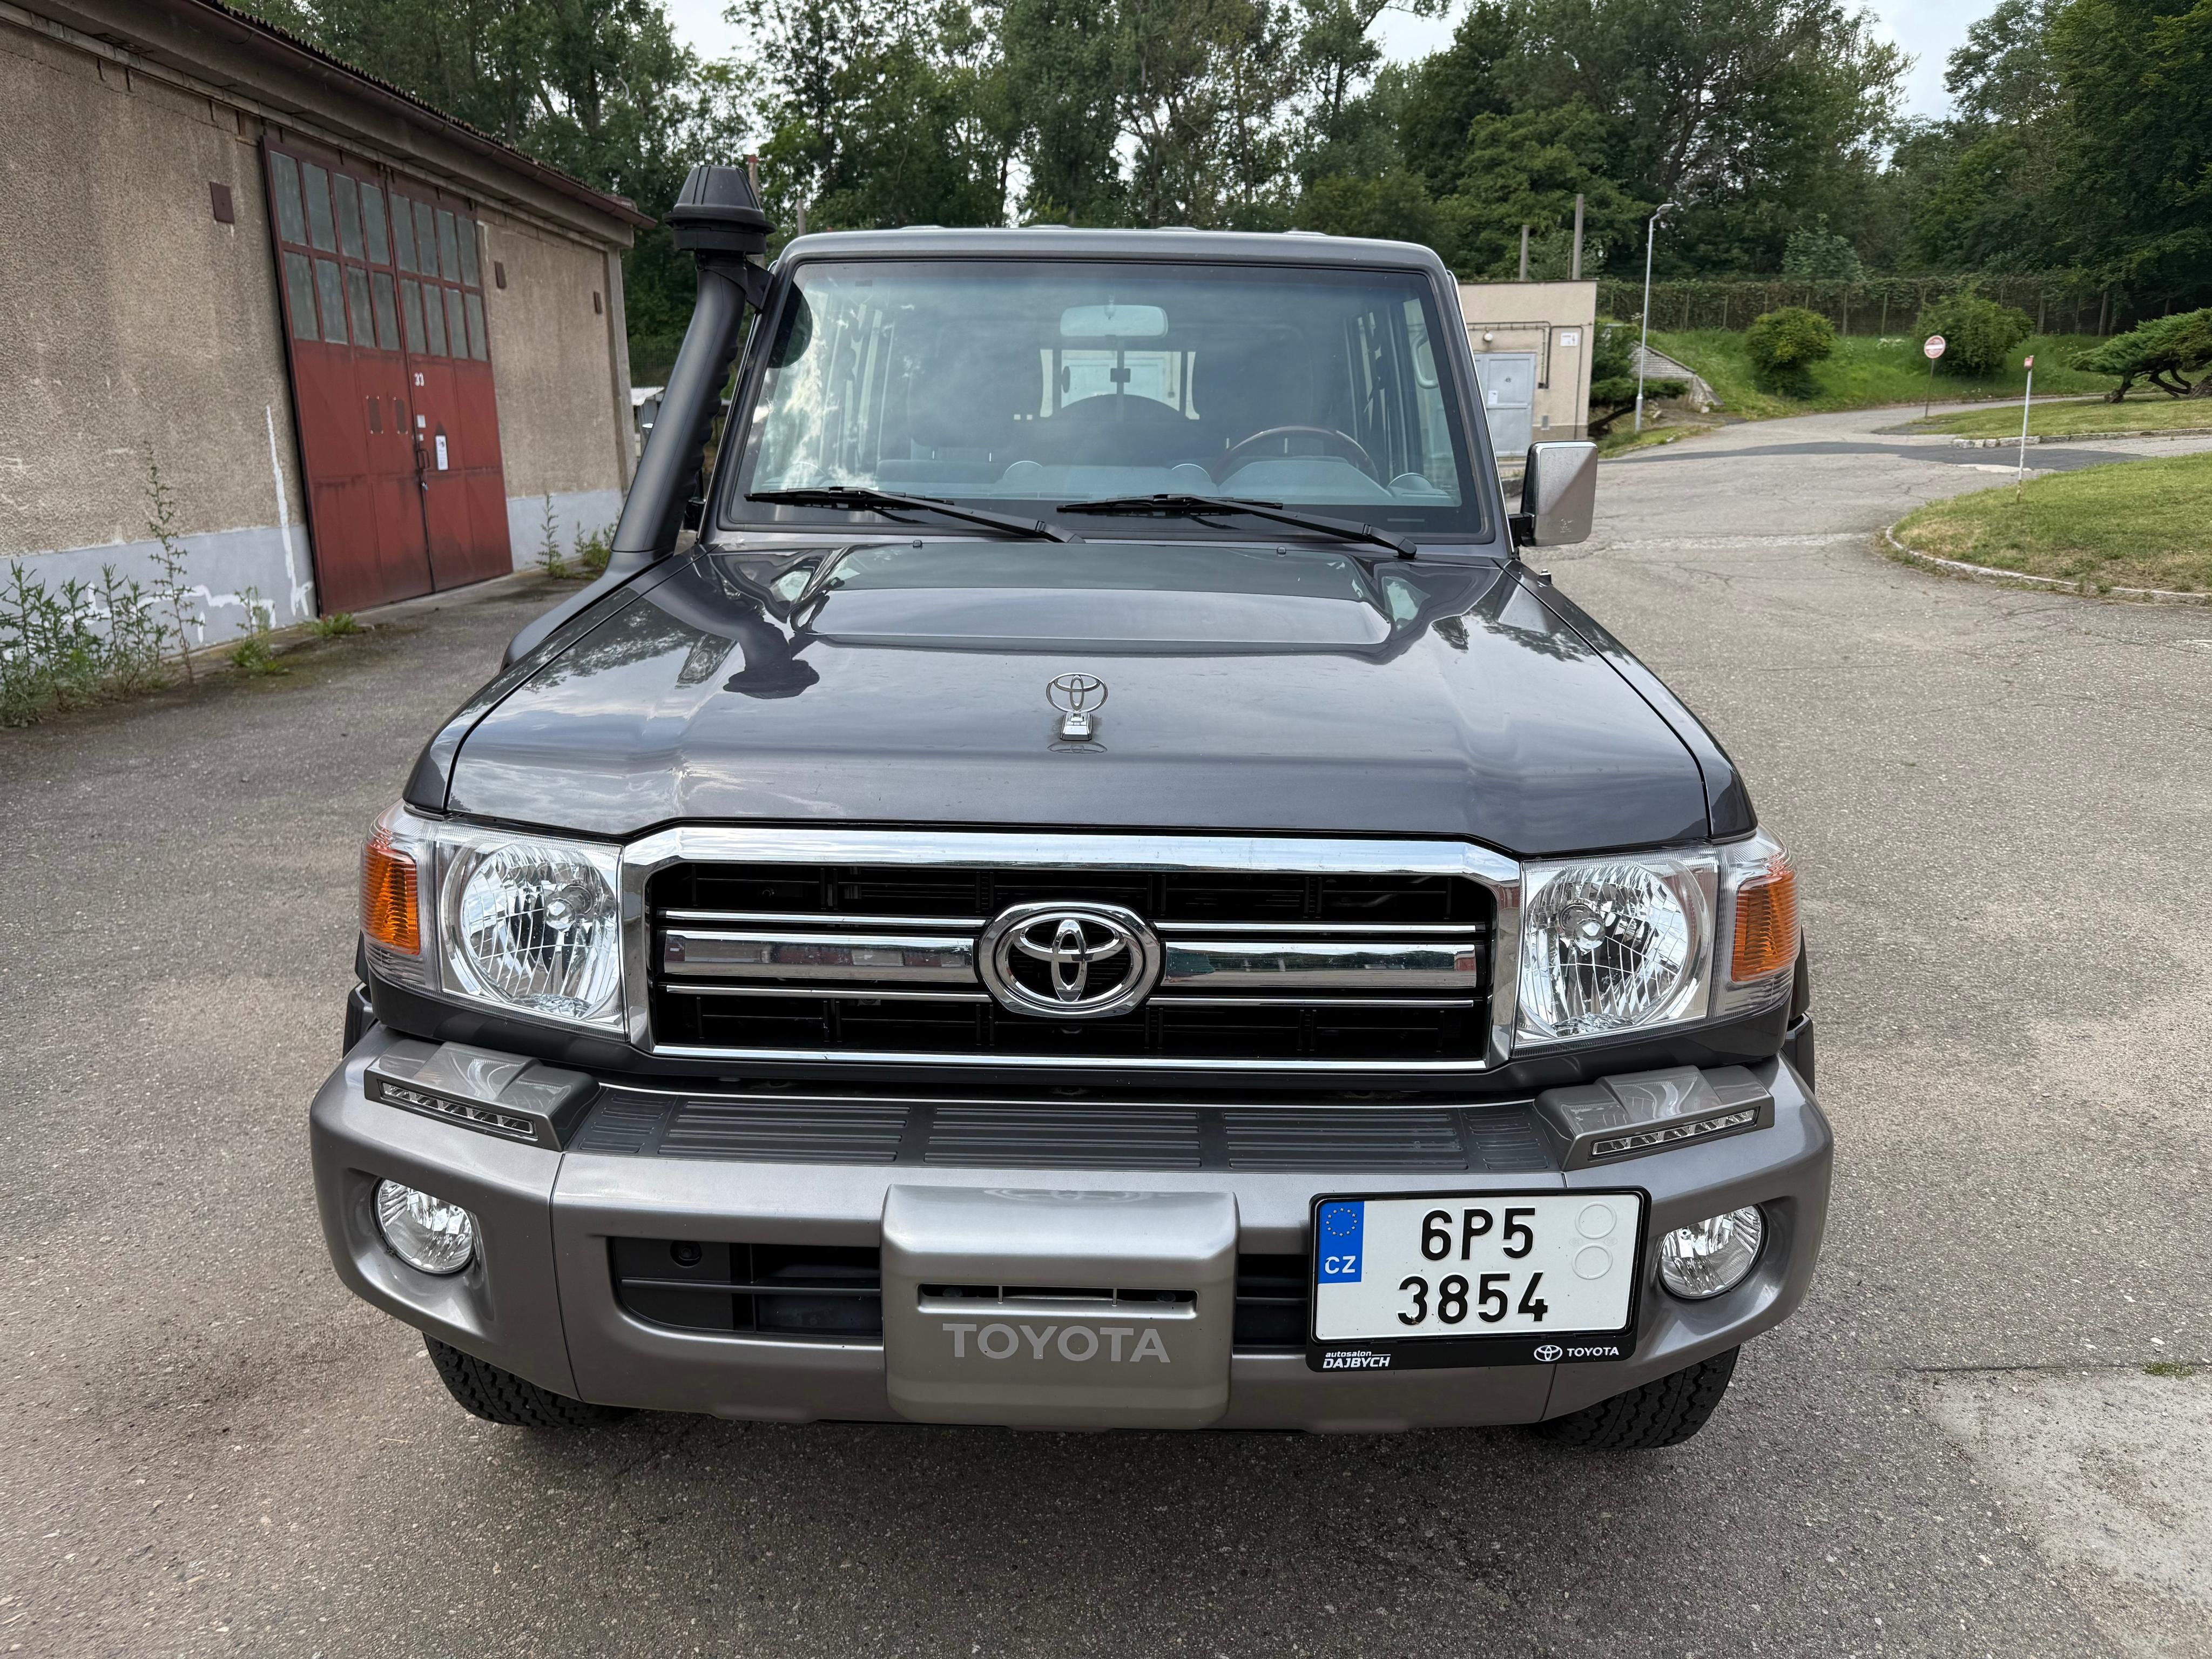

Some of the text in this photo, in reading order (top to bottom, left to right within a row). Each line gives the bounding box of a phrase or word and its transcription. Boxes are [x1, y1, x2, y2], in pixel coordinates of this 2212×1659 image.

[1421, 1207, 1536, 1261] 6P5
[1325, 1255, 1356, 1274] CZ
[1397, 1271, 1548, 1325] 3854
[942, 1323, 1171, 1363] TOYOTA
[1567, 1347, 1619, 1358] TOYOTA
[1323, 1357, 1391, 1368] DAJBYCH
